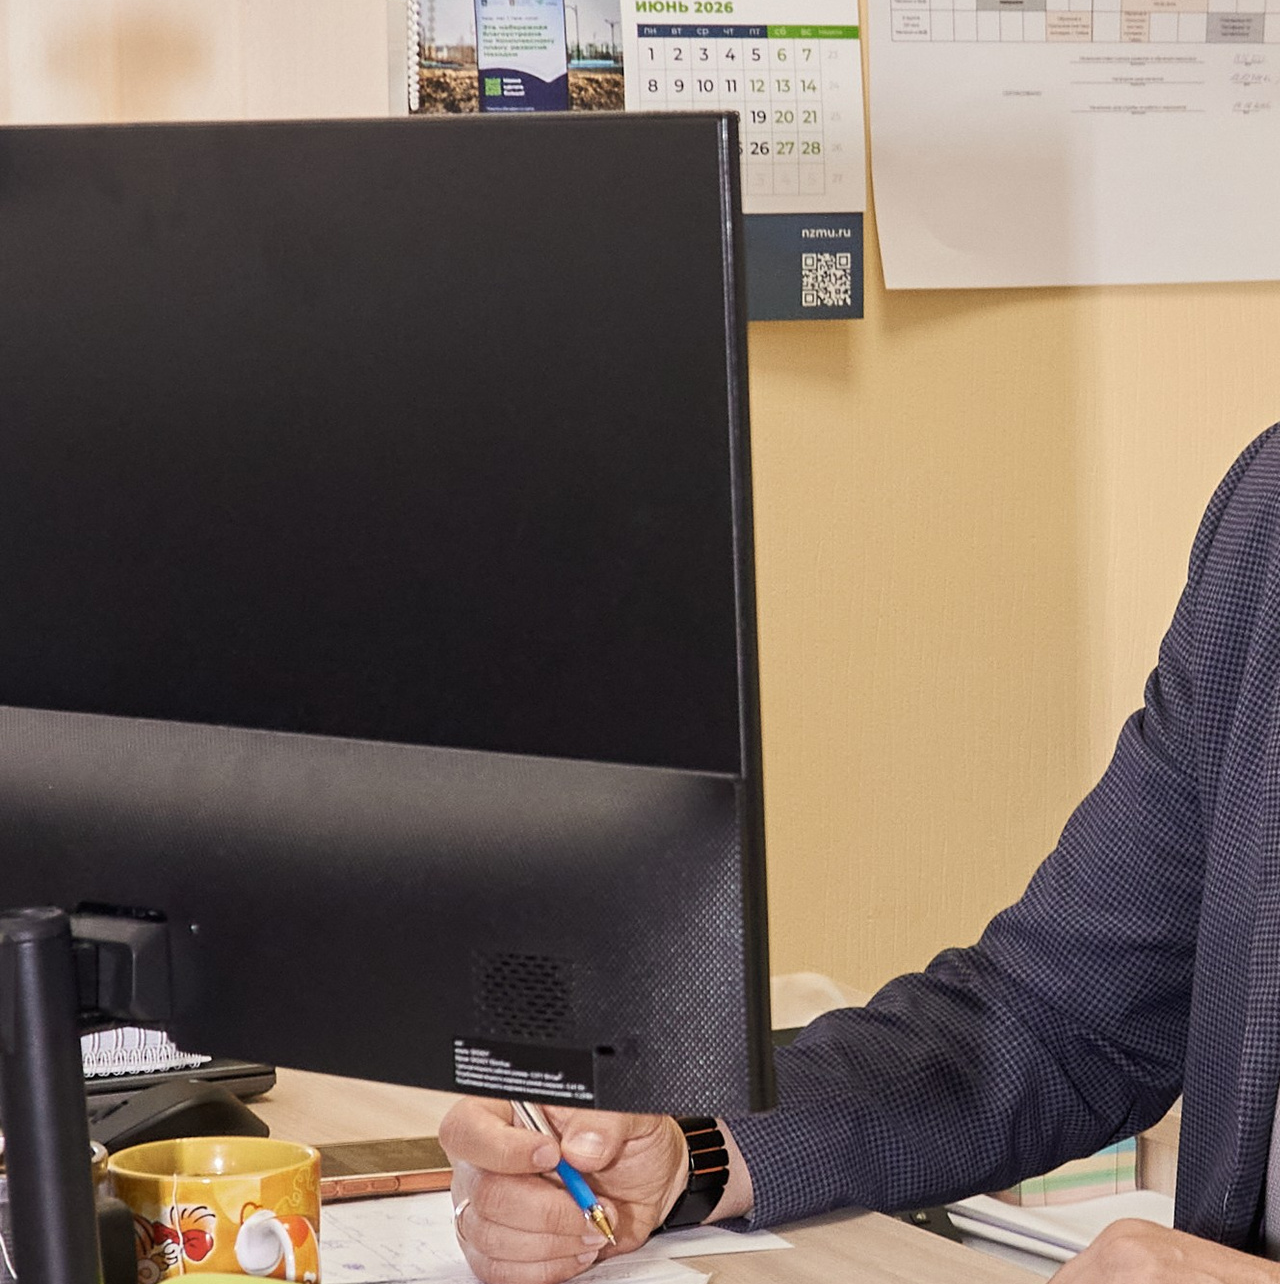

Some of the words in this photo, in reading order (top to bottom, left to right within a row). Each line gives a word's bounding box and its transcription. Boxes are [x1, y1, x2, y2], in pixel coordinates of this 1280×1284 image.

[636, 1, 688, 12] ИЮНЬ
[694, 2, 733, 13] 2026
[643, 27, 657, 36] пн
[671, 27, 682, 36] вт
[696, 28, 709, 37] ср
[722, 28, 734, 36] чт
[749, 28, 760, 36] пт
[649, 48, 653, 60] 1
[674, 48, 682, 60] 2
[700, 48, 708, 61] 3
[726, 49, 735, 60] 4
[753, 48, 760, 61] 5
[777, 48, 786, 61] 6
[802, 48, 811, 61] 7
[648, 80, 658, 92] 8
[675, 80, 684, 92] 9
[698, 80, 713, 92] 10
[726, 80, 736, 92] 11
[750, 79, 764, 92] 12
[776, 80, 790, 92] 13
[801, 80, 816, 92] 14
[752, 111, 766, 123] 19
[775, 111, 794, 123] 20
[803, 111, 817, 123] 21
[751, 142, 769, 155] 26
[777, 142, 794, 155] 27
[802, 142, 820, 154] 28
[802, 229, 850, 237] nzmu.ru
